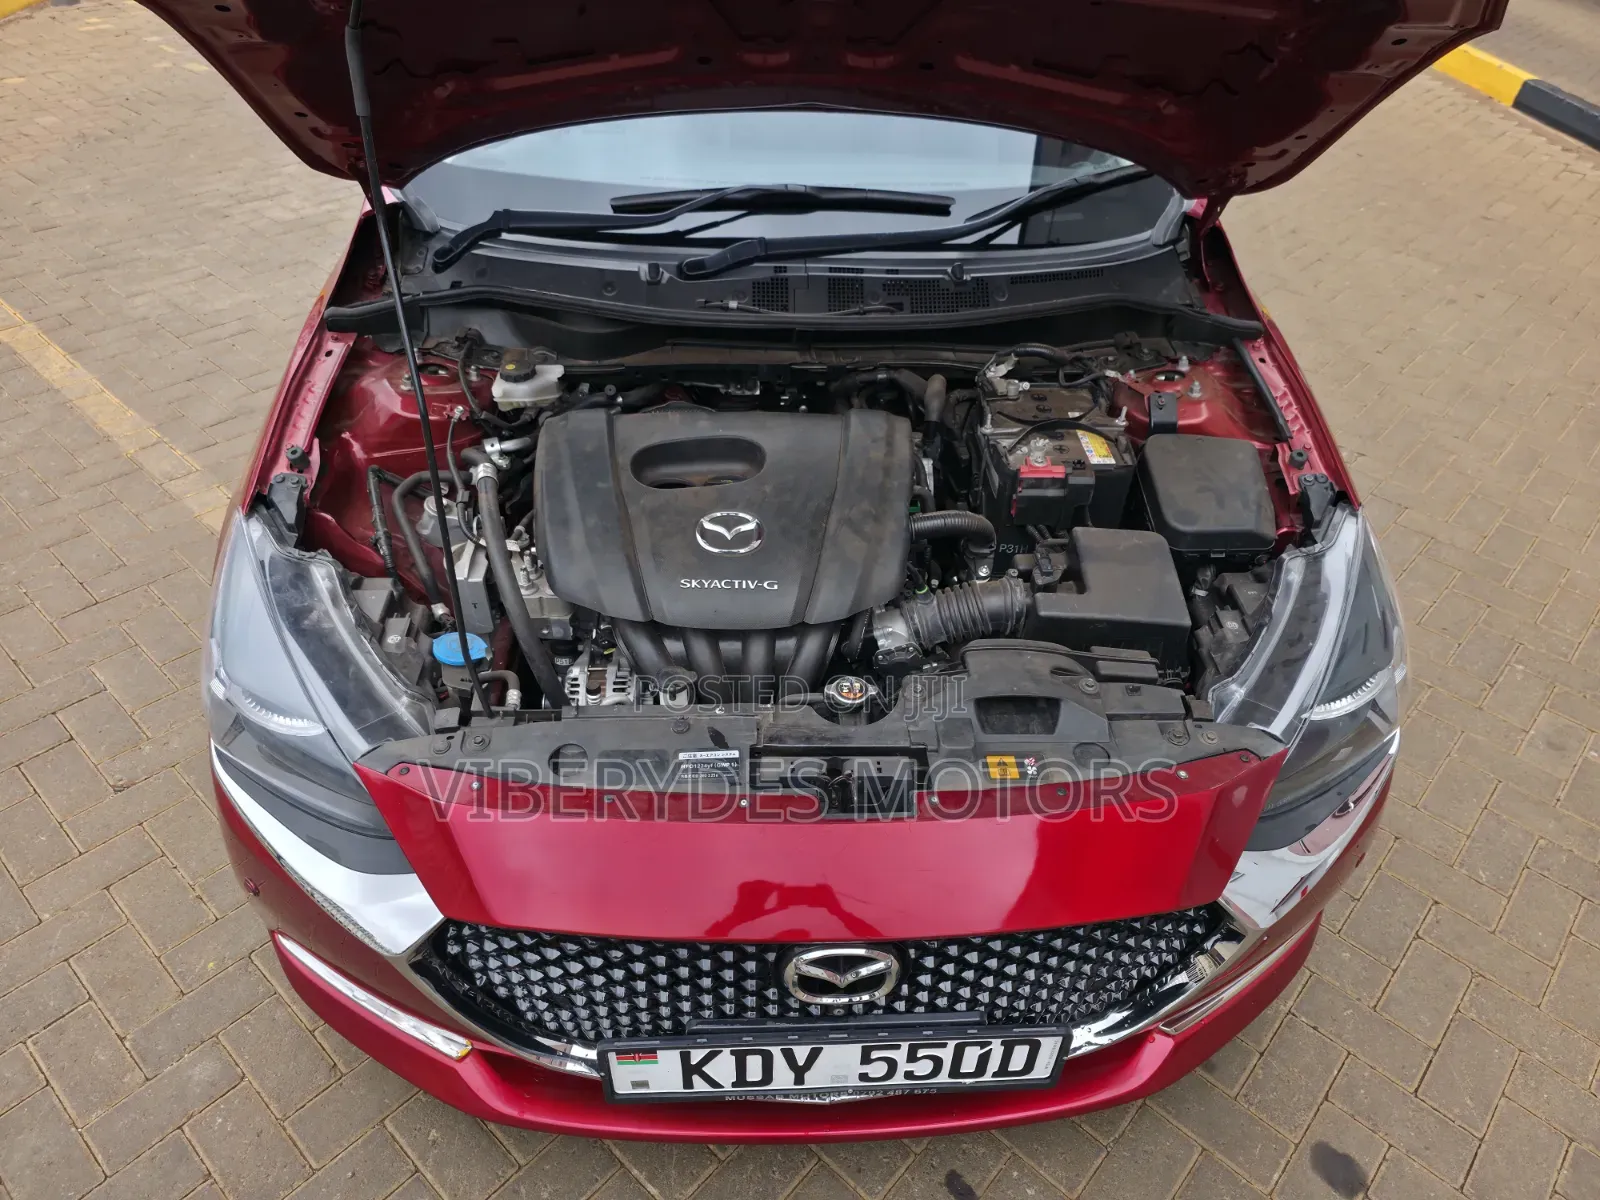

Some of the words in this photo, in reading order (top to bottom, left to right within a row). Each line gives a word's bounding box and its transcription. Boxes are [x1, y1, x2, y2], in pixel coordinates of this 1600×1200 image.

[680, 578, 779, 590] SKYACTIV-G
[680, 1046, 824, 1090] KDY
[857, 1038, 1040, 1084] 550D
[789, 1092, 847, 1100] MOTORS
